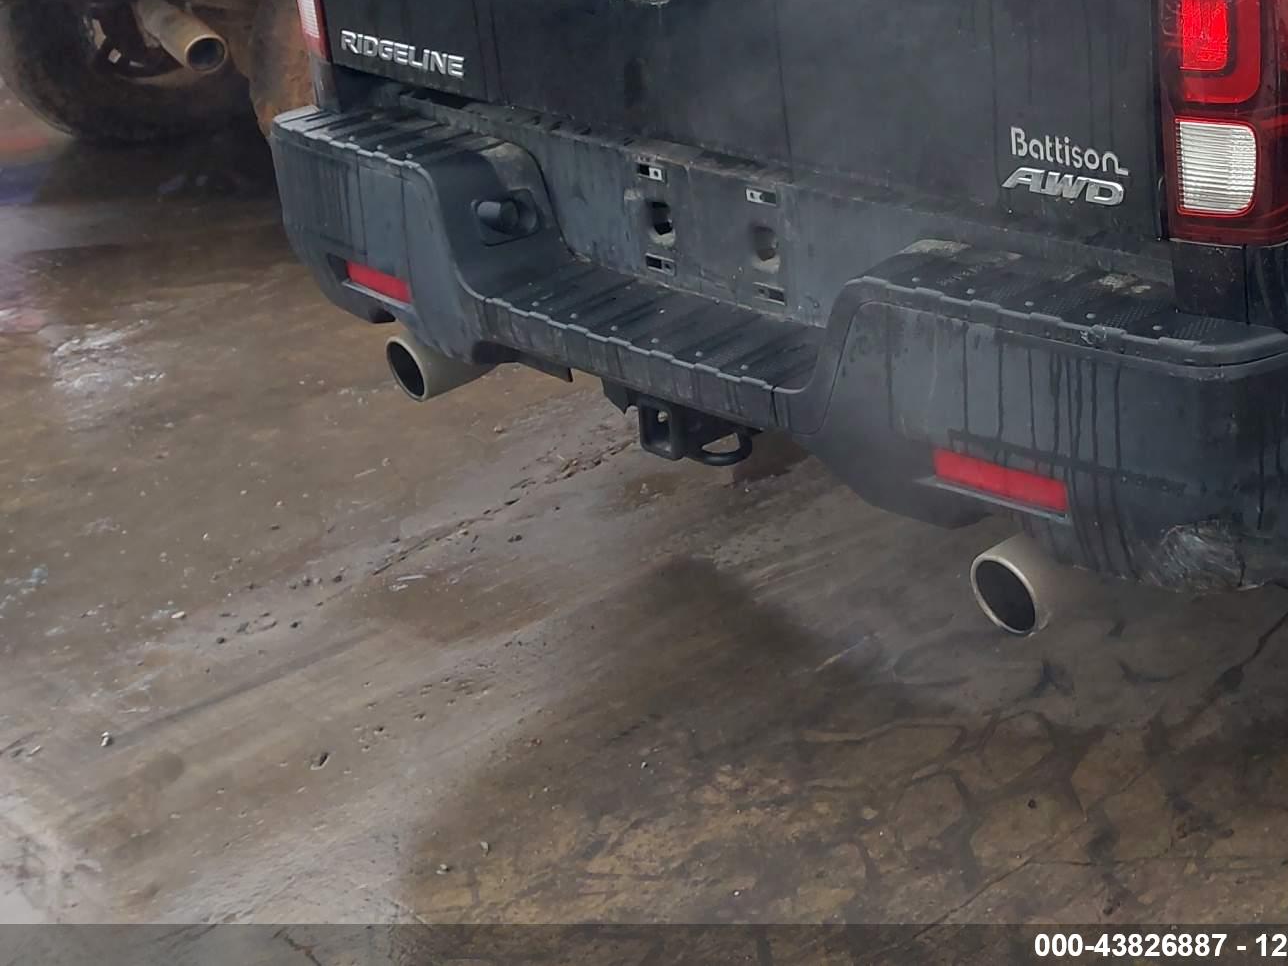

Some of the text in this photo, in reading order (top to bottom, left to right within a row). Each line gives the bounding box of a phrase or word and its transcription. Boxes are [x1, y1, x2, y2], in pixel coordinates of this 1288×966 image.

[341, 29, 465, 77] RIDGELINE
[1010, 126, 1129, 176] Battison
[1001, 167, 1125, 206] AWD
